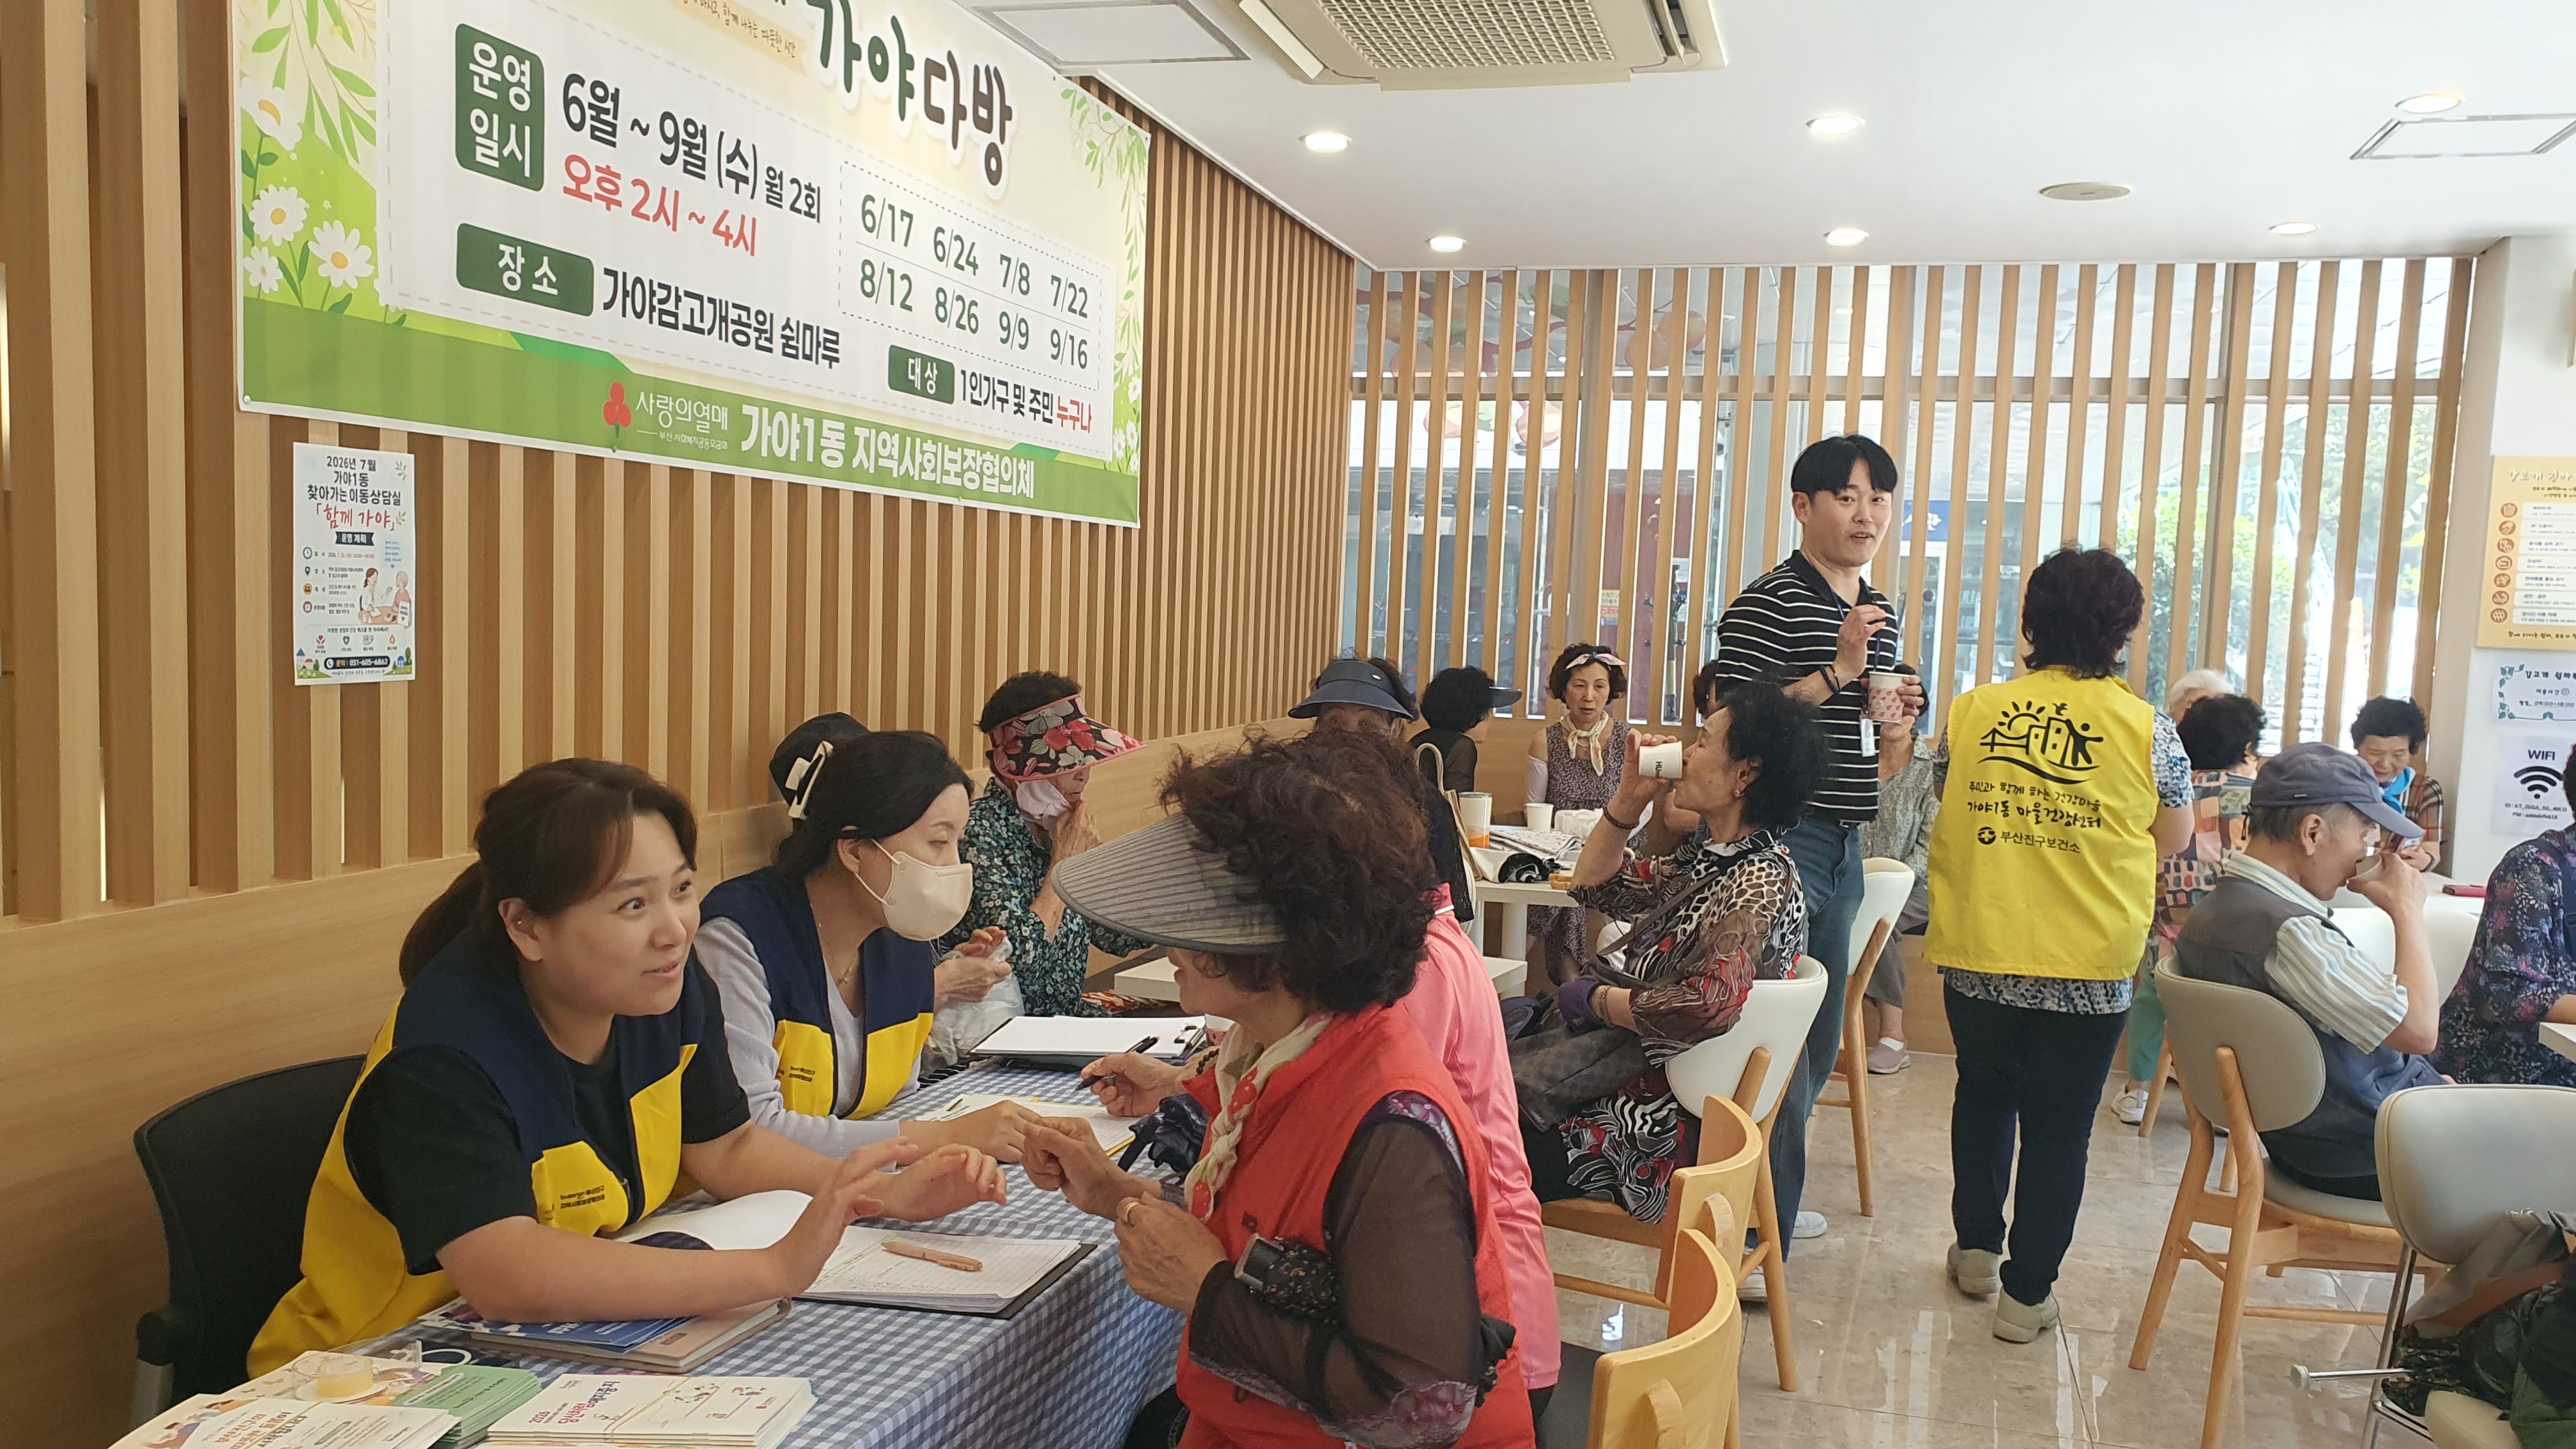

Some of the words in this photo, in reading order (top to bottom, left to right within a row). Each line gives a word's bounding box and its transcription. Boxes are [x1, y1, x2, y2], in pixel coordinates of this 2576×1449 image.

[723, 2, 739, 26] 함께
[741, 17, 758, 38] 나누는
[761, 29, 782, 52] 따뜻한
[785, 40, 796, 58] 시간
[468, 42, 531, 112] 운영
[805, 0, 1013, 186] 가야다방
[469, 108, 531, 178] 일시
[563, 73, 620, 148] 6월
[659, 111, 707, 181] 9월
[717, 130, 758, 200] (수)
[764, 165, 783, 209] 월
[789, 177, 820, 224] 2회
[563, 154, 622, 211] 오후
[631, 178, 680, 233] 2시
[712, 209, 756, 257] 4시
[861, 194, 914, 247] 6/17
[933, 226, 979, 276] 6/24
[999, 253, 1031, 296] 7/8
[1050, 274, 1088, 319] 7/22
[602, 266, 774, 354] 가야감고개공원
[779, 316, 840, 370] 쉼마루
[860, 259, 913, 312] 8/12
[935, 286, 979, 335] 8/26
[999, 310, 1029, 350] 9/9
[1050, 328, 1088, 369] 9/16
[636, 391, 728, 434] 사랑의열매
[960, 369, 1009, 413] 1인가구
[1013, 383, 1025, 417] 및
[1029, 387, 1054, 424] 주민
[1056, 395, 1092, 434] 누구나
[326, 455, 356, 470] 2026년
[360, 459, 376, 472] 7월
[741, 404, 845, 469] 가야1동
[852, 425, 1034, 499] 지역사회보장협의체
[2548, 469, 2576, 483] 쉼마
[307, 484, 348, 503] 찾아가는
[349, 487, 401, 507] 이동상담실
[334, 470, 369, 487] 가야1동
[2525, 670, 2549, 679] 감고개
[2527, 749, 2556, 762] WIFI
[1967, 800, 2010, 818] 가야1동
[1969, 781, 1996, 793] 주민과
[2000, 782, 2025, 795] 함께
[2029, 786, 2050, 801] 하는
[2054, 791, 2101, 813] 건강마을
[2000, 831, 2080, 854] 부산진구보건소
[213, 1413, 268, 1442] 부산진구의
